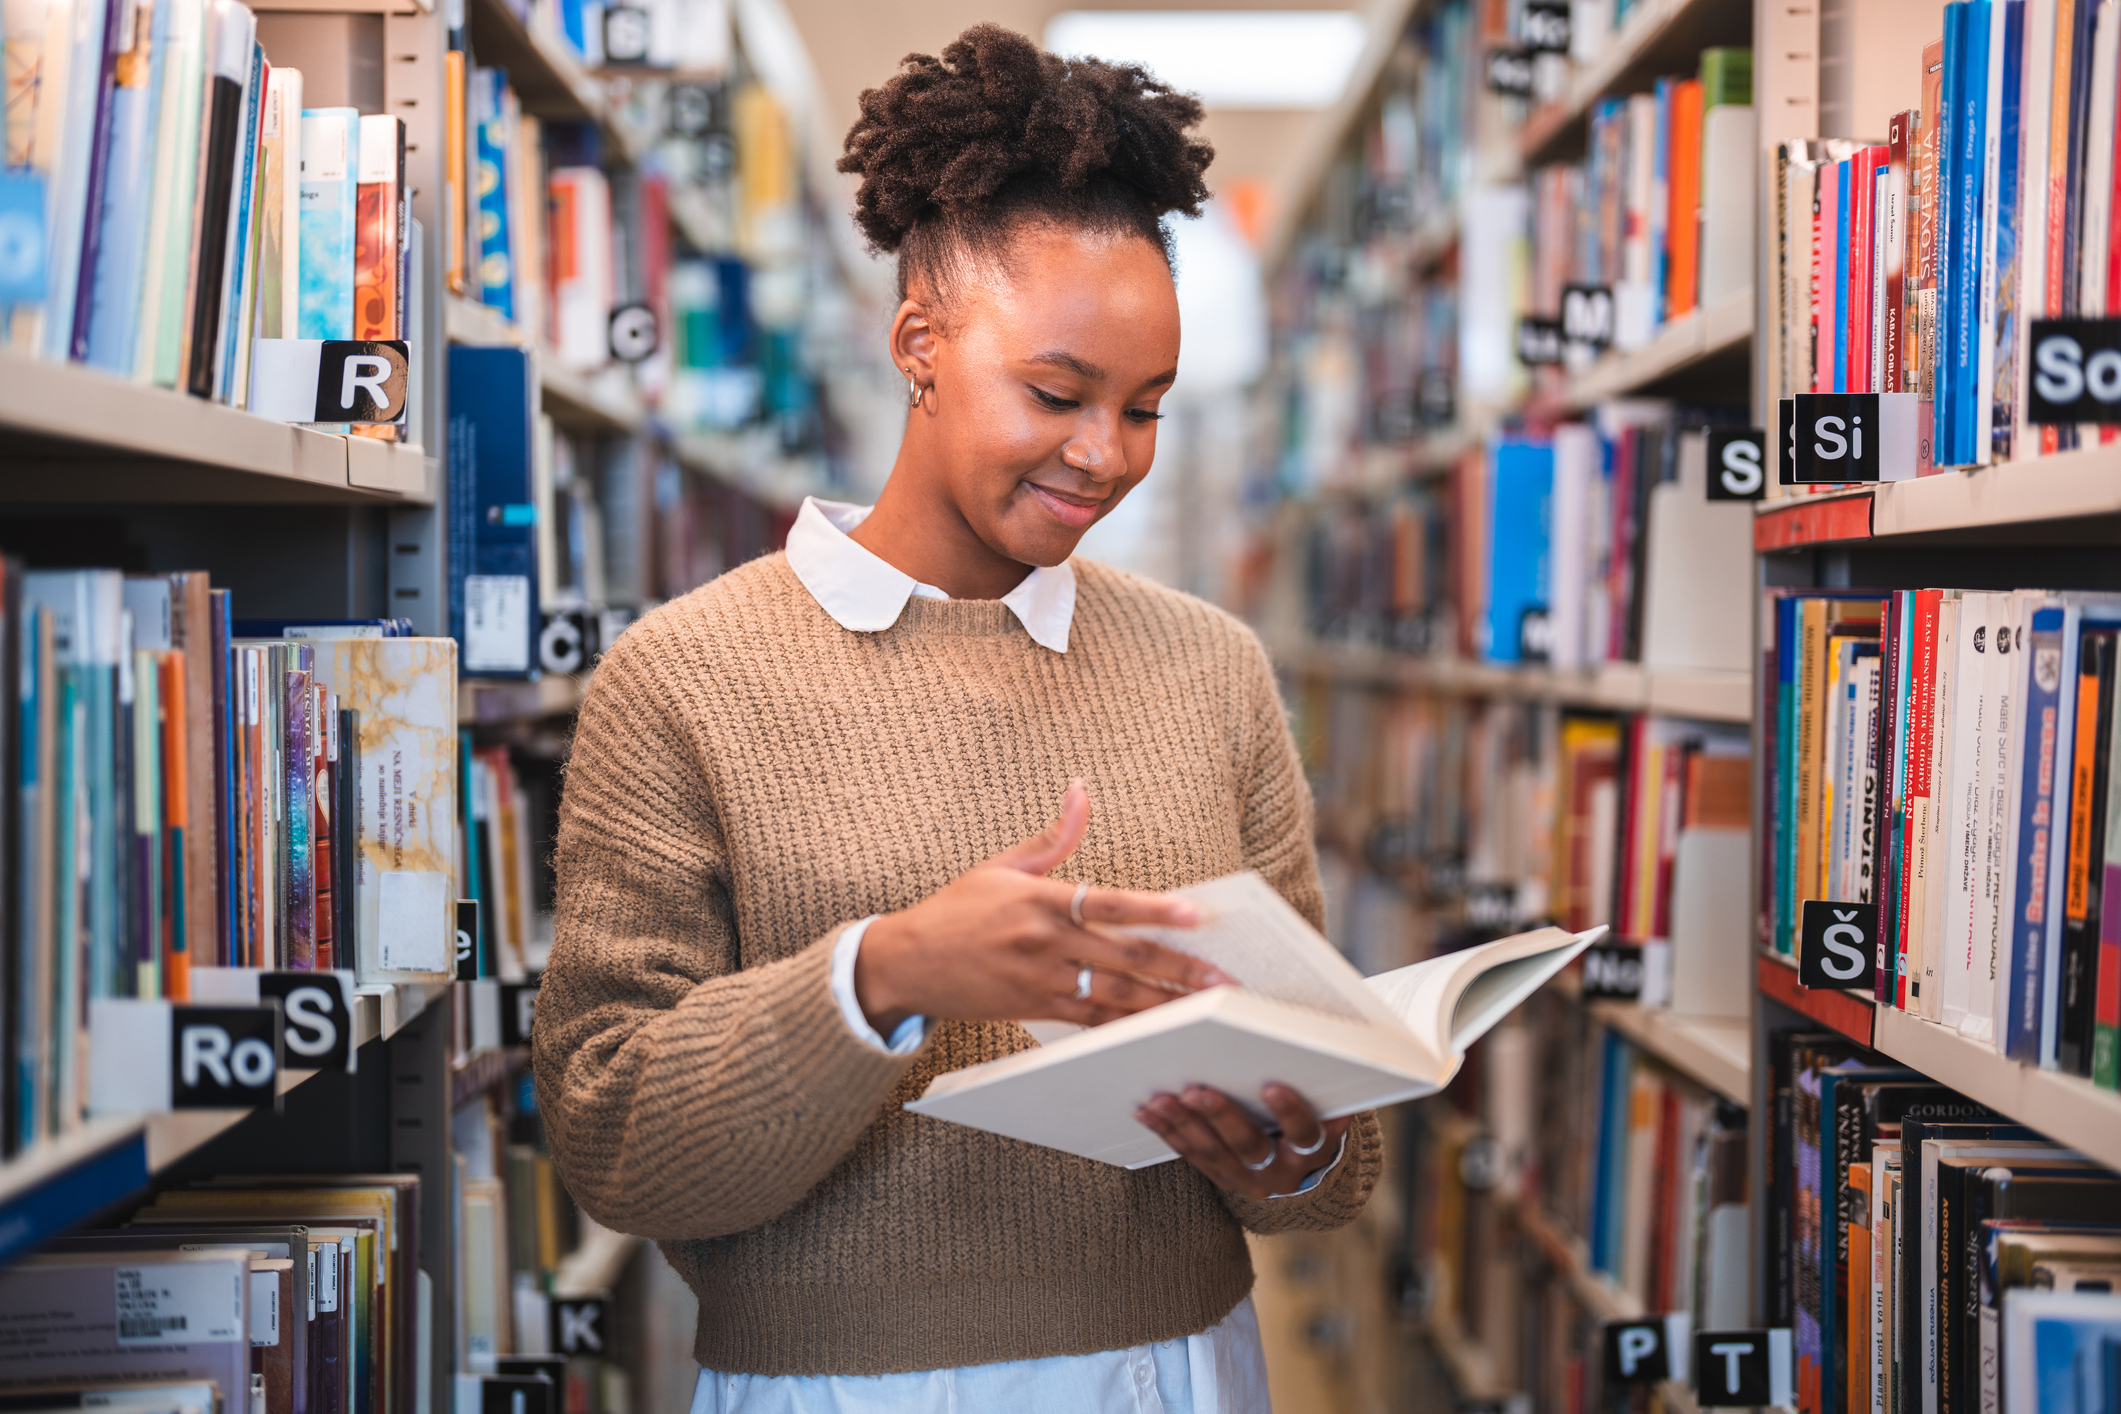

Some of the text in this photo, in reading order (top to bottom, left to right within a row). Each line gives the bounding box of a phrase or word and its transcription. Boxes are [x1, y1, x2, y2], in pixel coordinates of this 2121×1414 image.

[1920, 129, 1934, 281] SLOVENIJA
[1888, 308, 1896, 351] KABALA
[340, 355, 392, 409] R
[2033, 333, 2121, 405] So
[1813, 415, 1863, 461] Si
[1721, 439, 1763, 495] S
[539, 617, 583, 673] C
[1883, 800, 1890, 819] NA
[1890, 636, 1898, 690] TISOČLETJE
[1917, 611, 1932, 792] ZAHOD IN MUSLIMANSKI SVET
[1928, 683, 1936, 742] REAKCIJE
[1997, 694, 2010, 734] Matej
[1909, 707, 1917, 760] STRANEH
[1901, 757, 1909, 814] SLOVENCI
[1907, 764, 1915, 795] DVEH
[1926, 755, 1934, 792] AKCIJE
[1997, 772, 2006, 786] in
[393, 750, 404, 868] NA MEJI RESNIČNEGA
[1860, 774, 1875, 879] STANIC
[1905, 797, 1913, 819] NA
[1934, 805, 1942, 835] Skupina
[1988, 785, 1996, 826] TRILOGIJA
[1917, 803, 1927, 879] Primož Šterbenc
[1993, 821, 2003, 868] Zgaga
[1962, 859, 1970, 893] DRŽAVE
[1820, 907, 1867, 981] Š
[284, 986, 337, 1056] S
[181, 1024, 276, 1087] Ro
[1851, 1106, 1861, 1162] OSADA
[1908, 1103, 1988, 1117] GORDON
[1838, 1104, 1850, 1261] SKRIVNOSTNA
[1940, 1197, 1950, 1274] odnosov
[1966, 1230, 1980, 1318] Razdalje
[559, 1303, 601, 1351] K
[1617, 1326, 1658, 1378] P
[1875, 1331, 1883, 1366] proti
[1940, 1279, 1950, 1399] mednarodnih
[1709, 1343, 1754, 1395] T
[1928, 1339, 1936, 1385] evropa
[1875, 1373, 1883, 1407] Pisma
